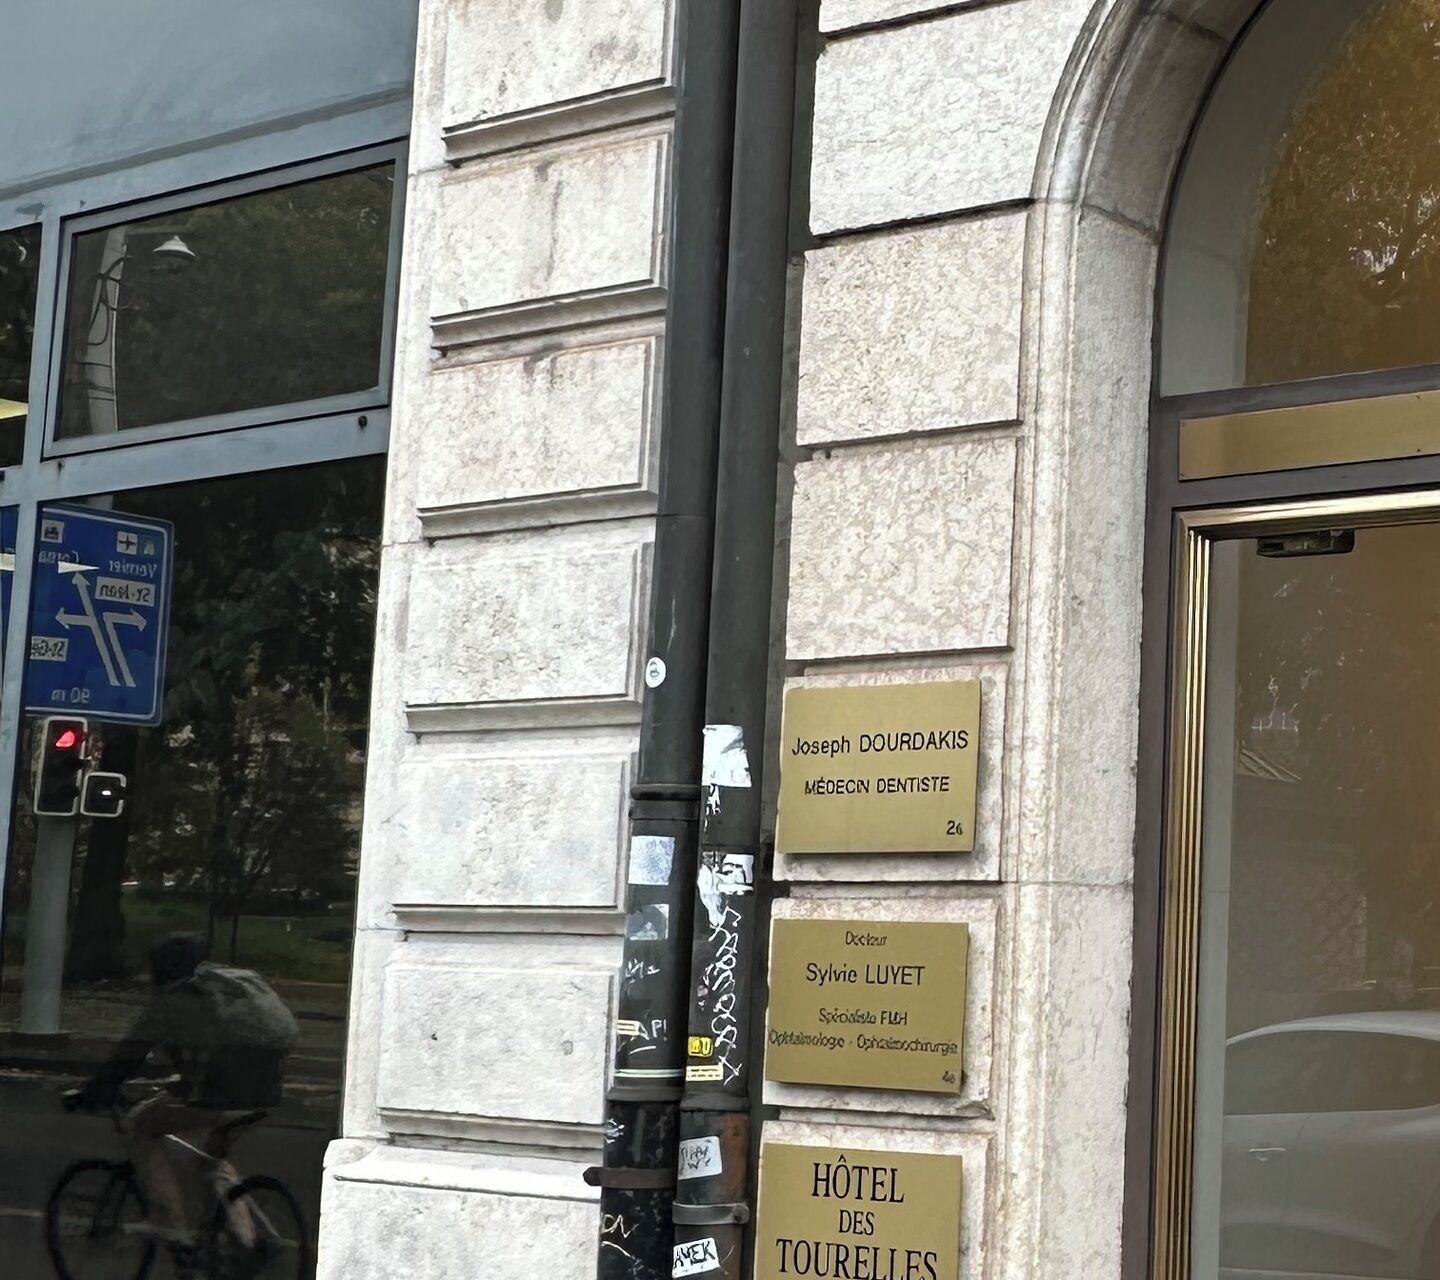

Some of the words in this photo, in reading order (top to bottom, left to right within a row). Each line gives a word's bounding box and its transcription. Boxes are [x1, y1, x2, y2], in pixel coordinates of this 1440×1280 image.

[791, 735, 850, 757] Joseph
[859, 730, 969, 752] DOURDAKIS
[804, 777, 870, 795] MÉDECIN
[876, 776, 950, 794] DENTISTE
[806, 963, 857, 986] Sylvie
[865, 964, 925, 986] LUYET
[811, 1154, 905, 1203] HÔTEL
[838, 1209, 875, 1236] DES
